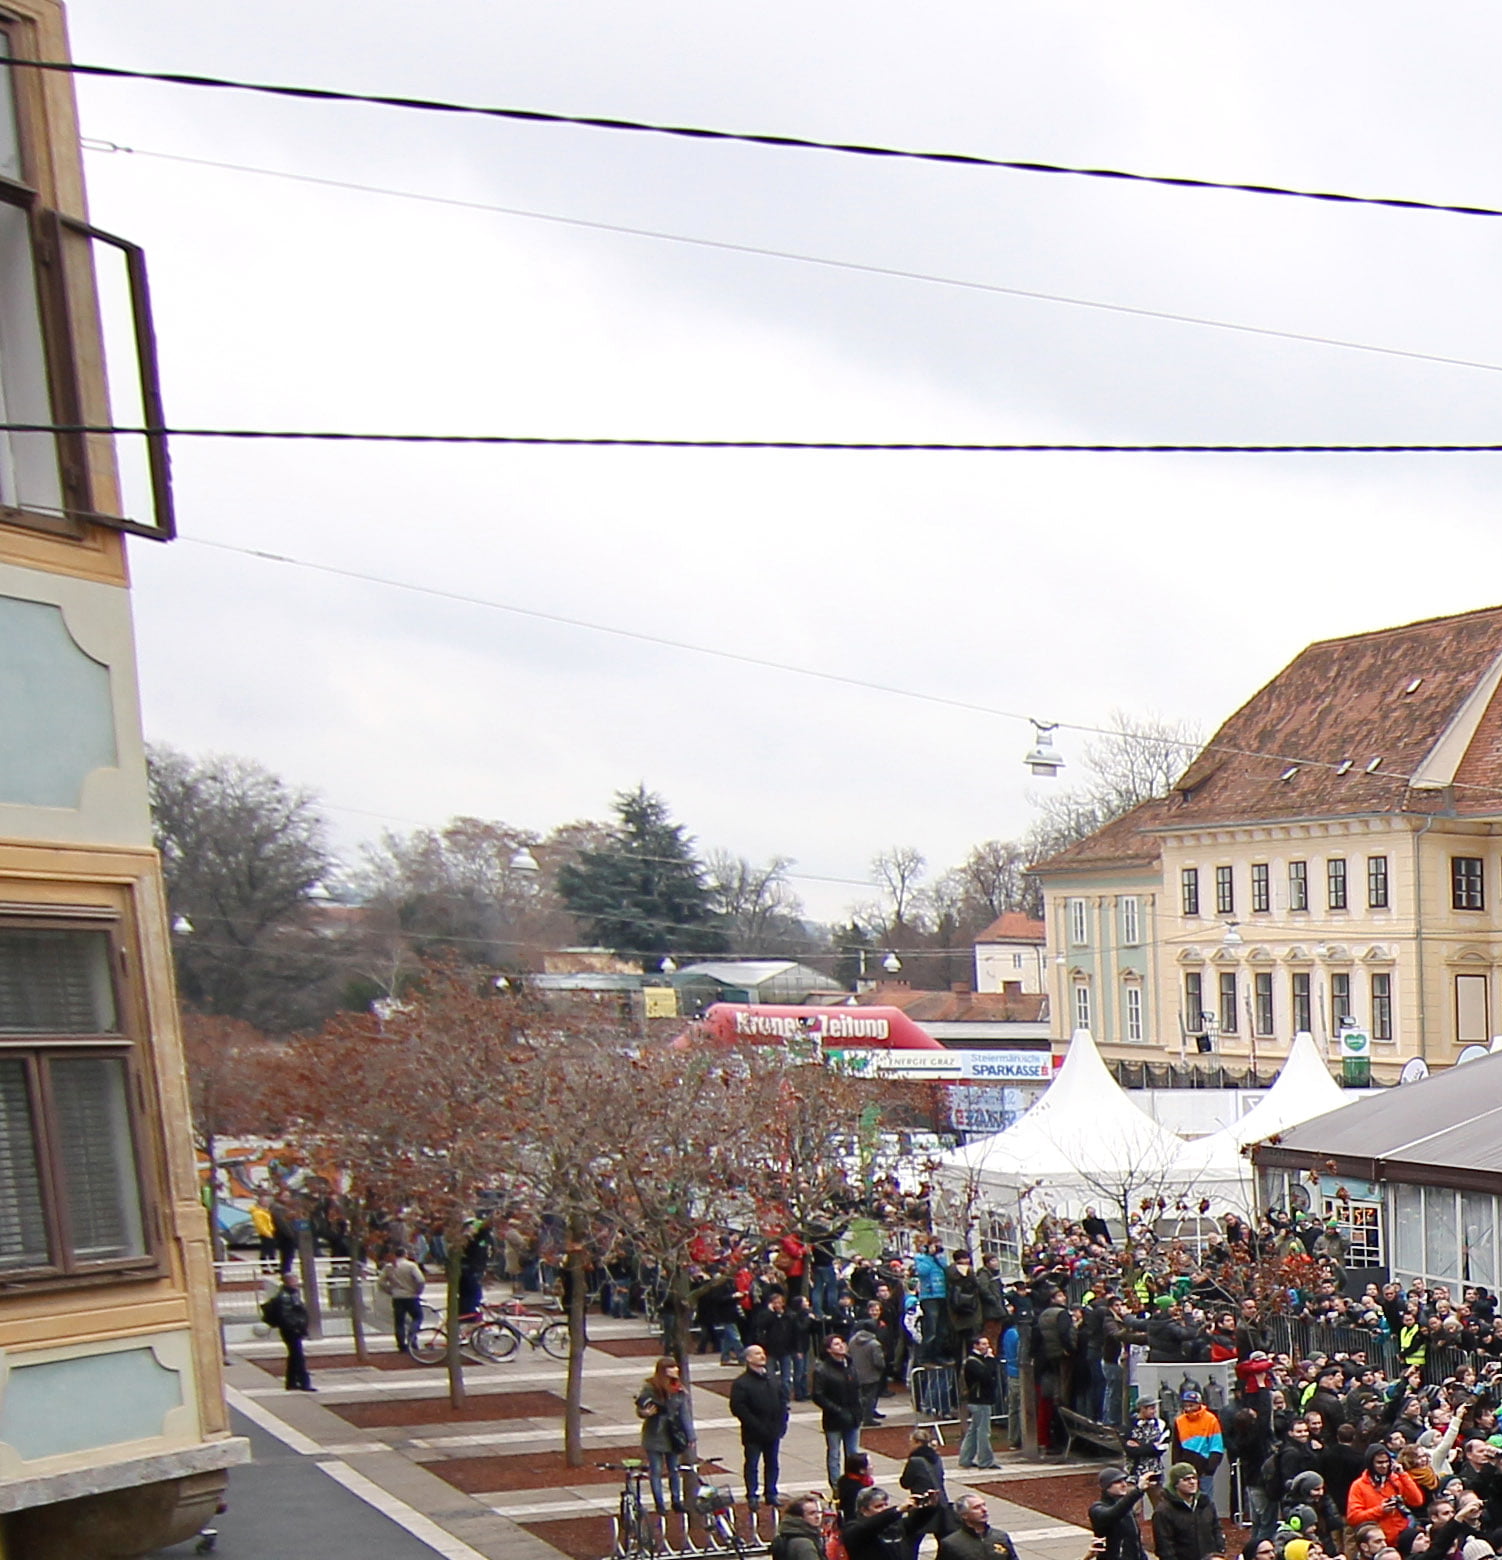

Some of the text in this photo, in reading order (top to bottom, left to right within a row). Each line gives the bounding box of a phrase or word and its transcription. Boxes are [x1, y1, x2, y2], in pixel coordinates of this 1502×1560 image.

[817, 1014, 889, 1040] Zeitung
[929, 1056, 956, 1067] GRAZ
[971, 1063, 1041, 1078] SPARKASSE
